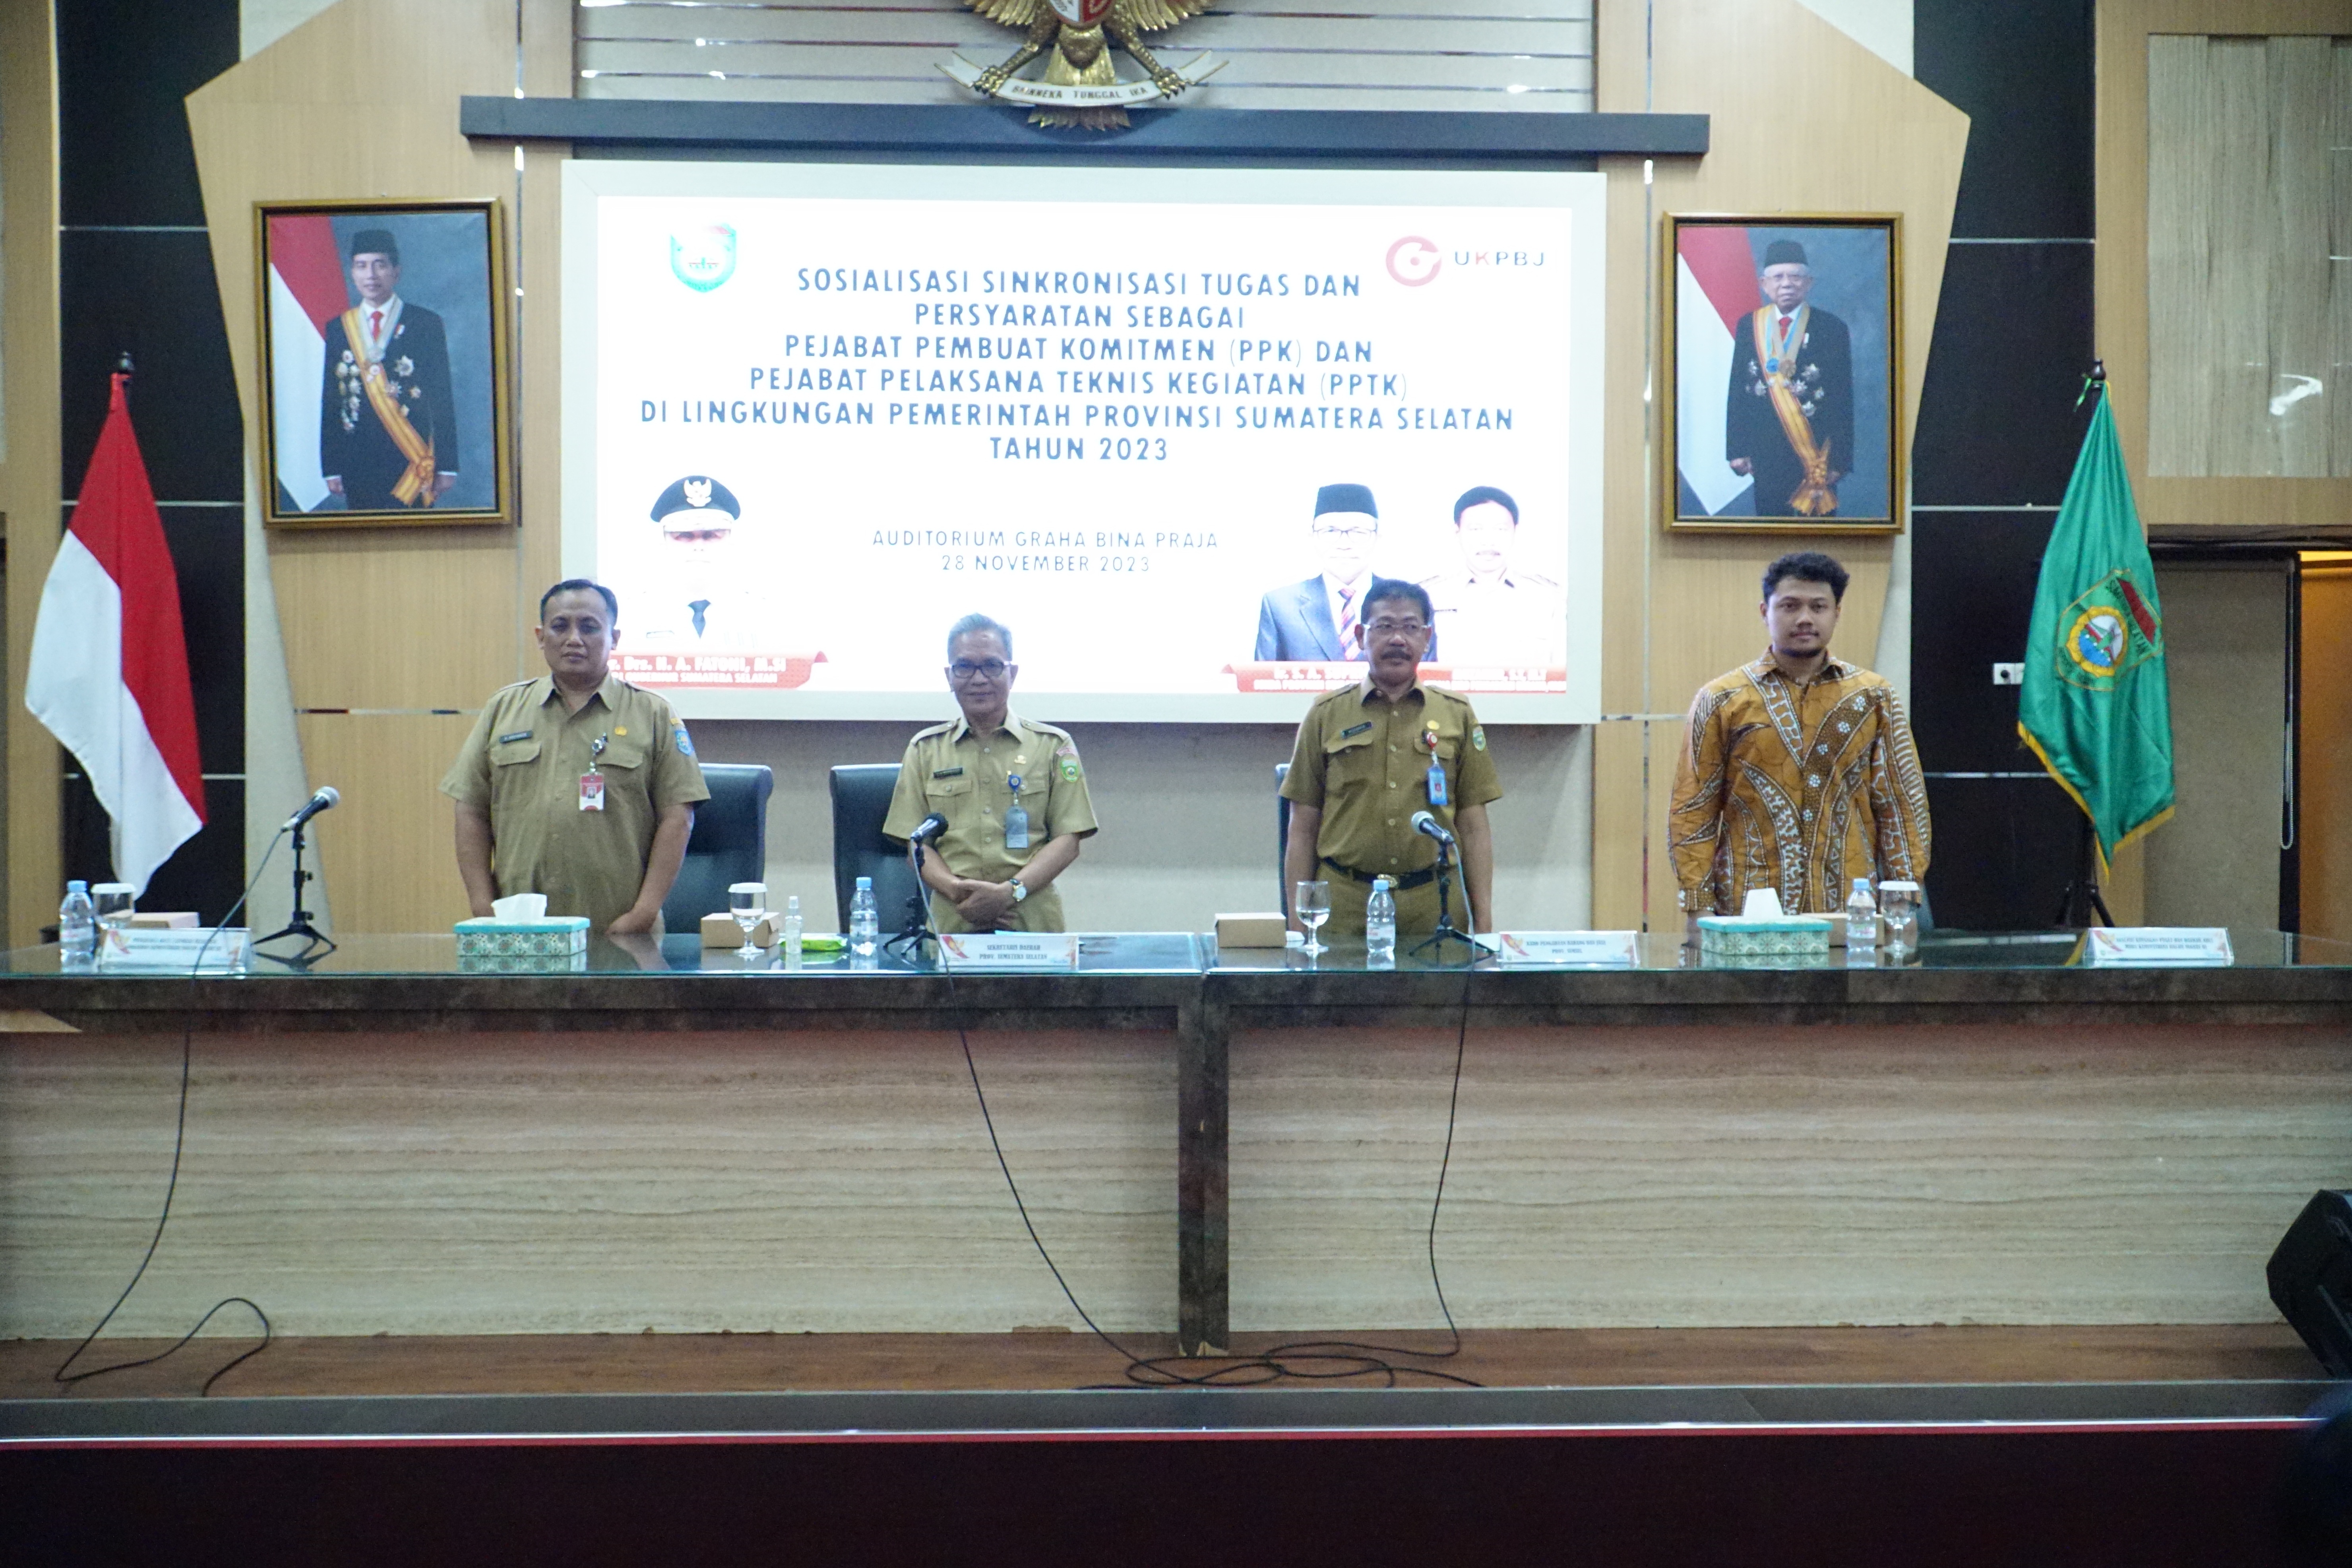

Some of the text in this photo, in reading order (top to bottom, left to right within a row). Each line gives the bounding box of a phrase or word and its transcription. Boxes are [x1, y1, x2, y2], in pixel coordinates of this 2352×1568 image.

[1455, 251, 1544, 266] UKPBJ
[798, 267, 1359, 297] SOSIALISASI SINKRONISASI TUGAS DAN
[915, 303, 1243, 329] PERSYARATAN SEBAGAI
[785, 334, 1372, 368] PEJABAT PEMBUAT KOMITMEN (PPK) DAN
[750, 367, 1406, 401] PEJABAT PELAKSANA TEKNIS KEGIATAN (PPTK)
[641, 400, 1512, 430] DI LINGKUNGAN PEMERINTAH PROVINSI SUMATERA SELATAN
[989, 436, 1167, 461] TAHUN 2023
[872, 530, 1217, 548] AUDITORIUM GRAHA BINA PRAJA
[942, 554, 1149, 572] 28 NOVEMBER 2023
[680, 673, 733, 683] SUMATERA
[734, 673, 778, 683] SELATAN
